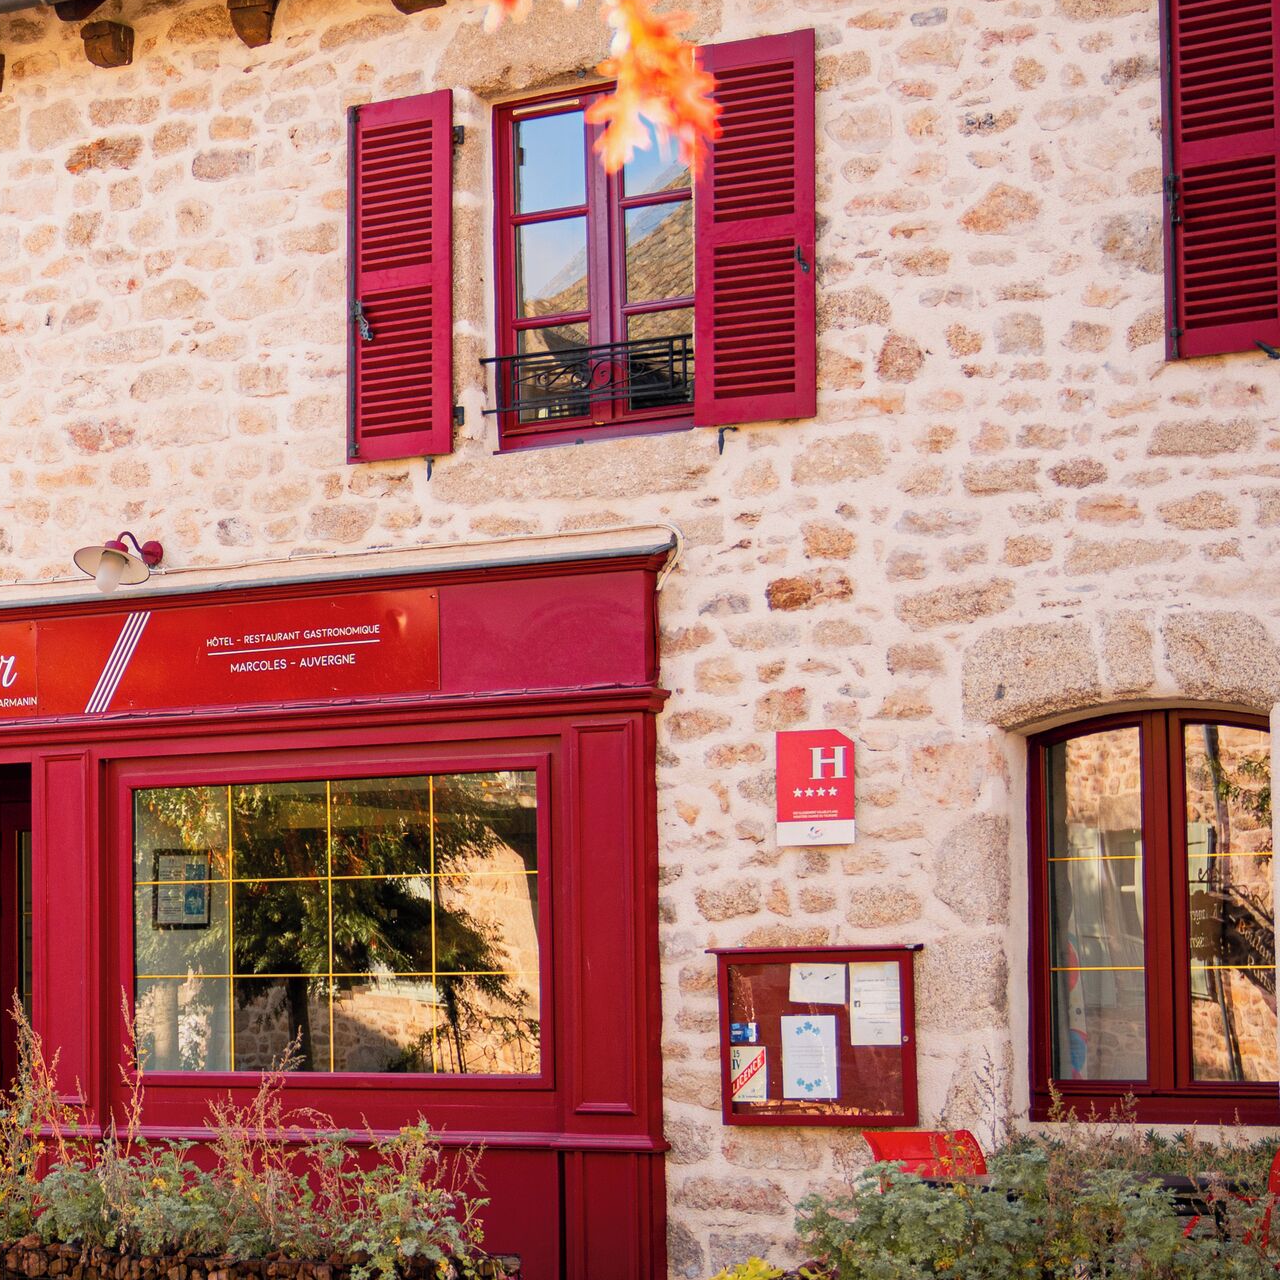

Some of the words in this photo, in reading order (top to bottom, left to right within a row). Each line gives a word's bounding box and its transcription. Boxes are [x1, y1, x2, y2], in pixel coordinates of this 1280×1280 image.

[206, 636, 234, 648] HÔTEL
[243, 630, 301, 644] RESTAURANT
[303, 624, 381, 639] GASTRONOMIQUE
[230, 658, 287, 673] MARCOLES
[299, 653, 356, 668] AUVERGNE
[808, 745, 848, 780] H
[732, 1058, 741, 1070] IV
[732, 1055, 762, 1094] LICENCE
